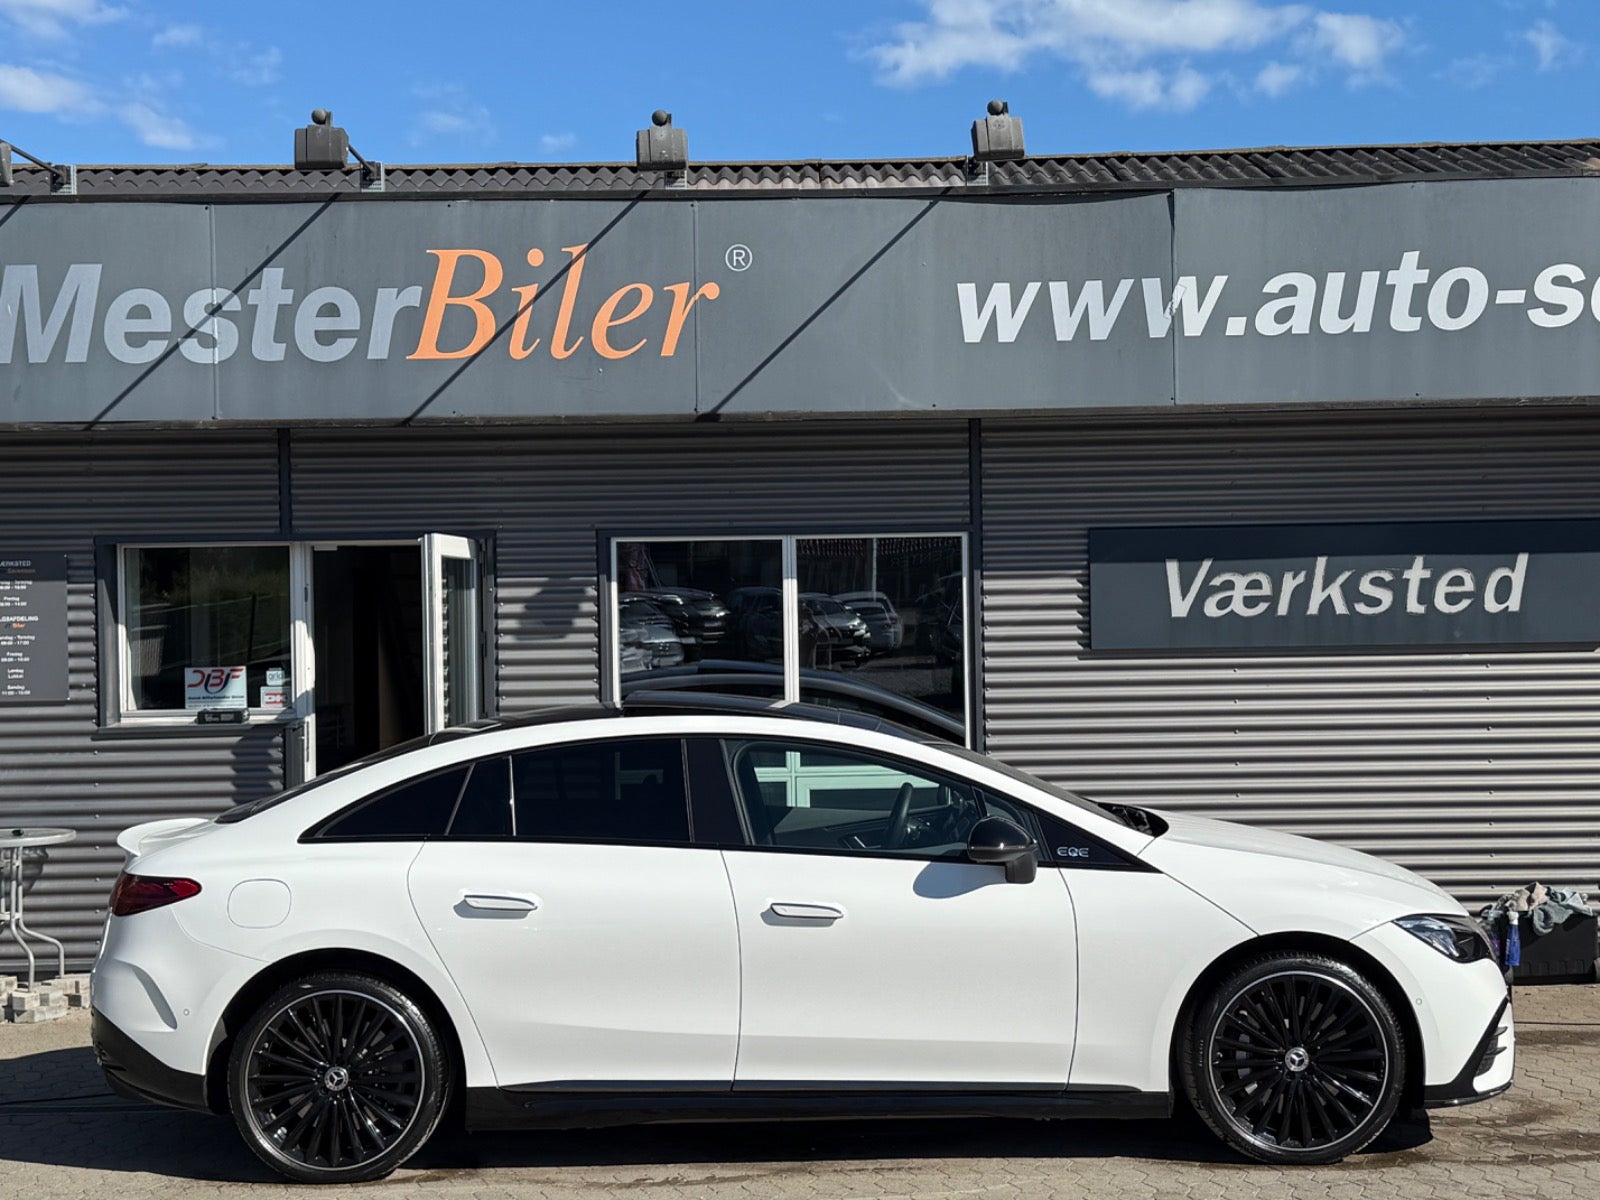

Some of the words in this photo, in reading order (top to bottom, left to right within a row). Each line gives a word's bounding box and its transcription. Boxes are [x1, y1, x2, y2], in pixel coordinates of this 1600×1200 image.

[956, 250, 1600, 343] www.auto-s
[1165, 552, 1529, 618] Værksted
[1057, 846, 1089, 858] EQE
